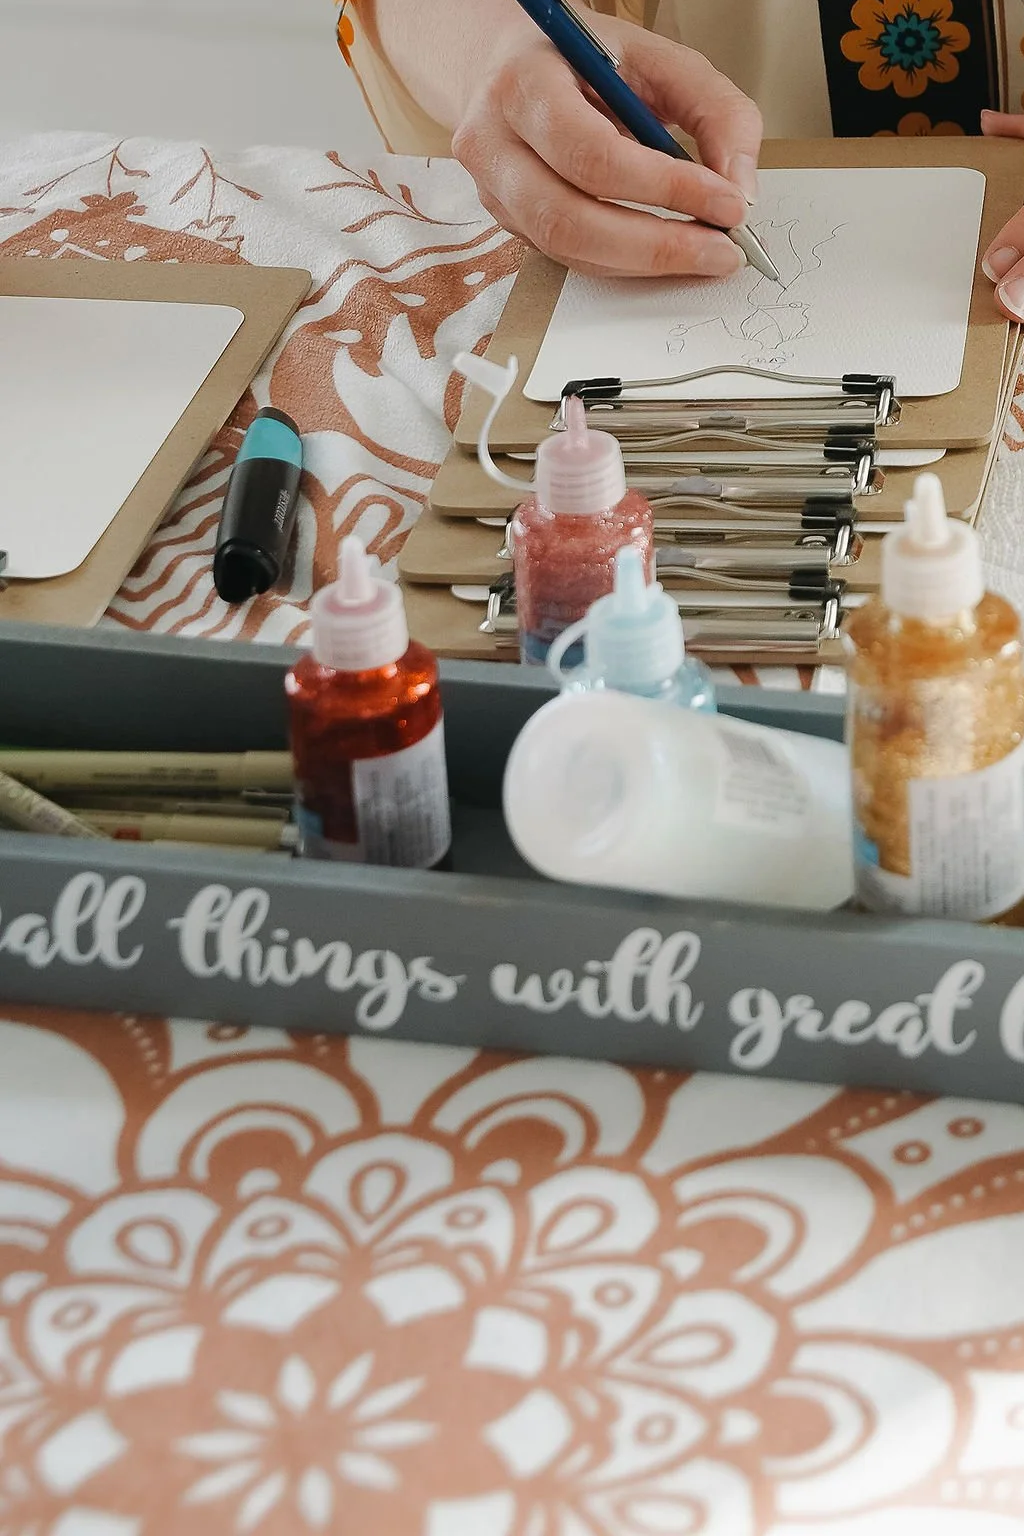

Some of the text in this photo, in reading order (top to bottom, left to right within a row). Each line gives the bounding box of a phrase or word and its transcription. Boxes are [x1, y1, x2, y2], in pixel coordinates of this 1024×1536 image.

[0, 871, 146, 968] all
[168, 884, 466, 1030] things
[490, 927, 704, 1030] with
[728, 959, 986, 1068] great
